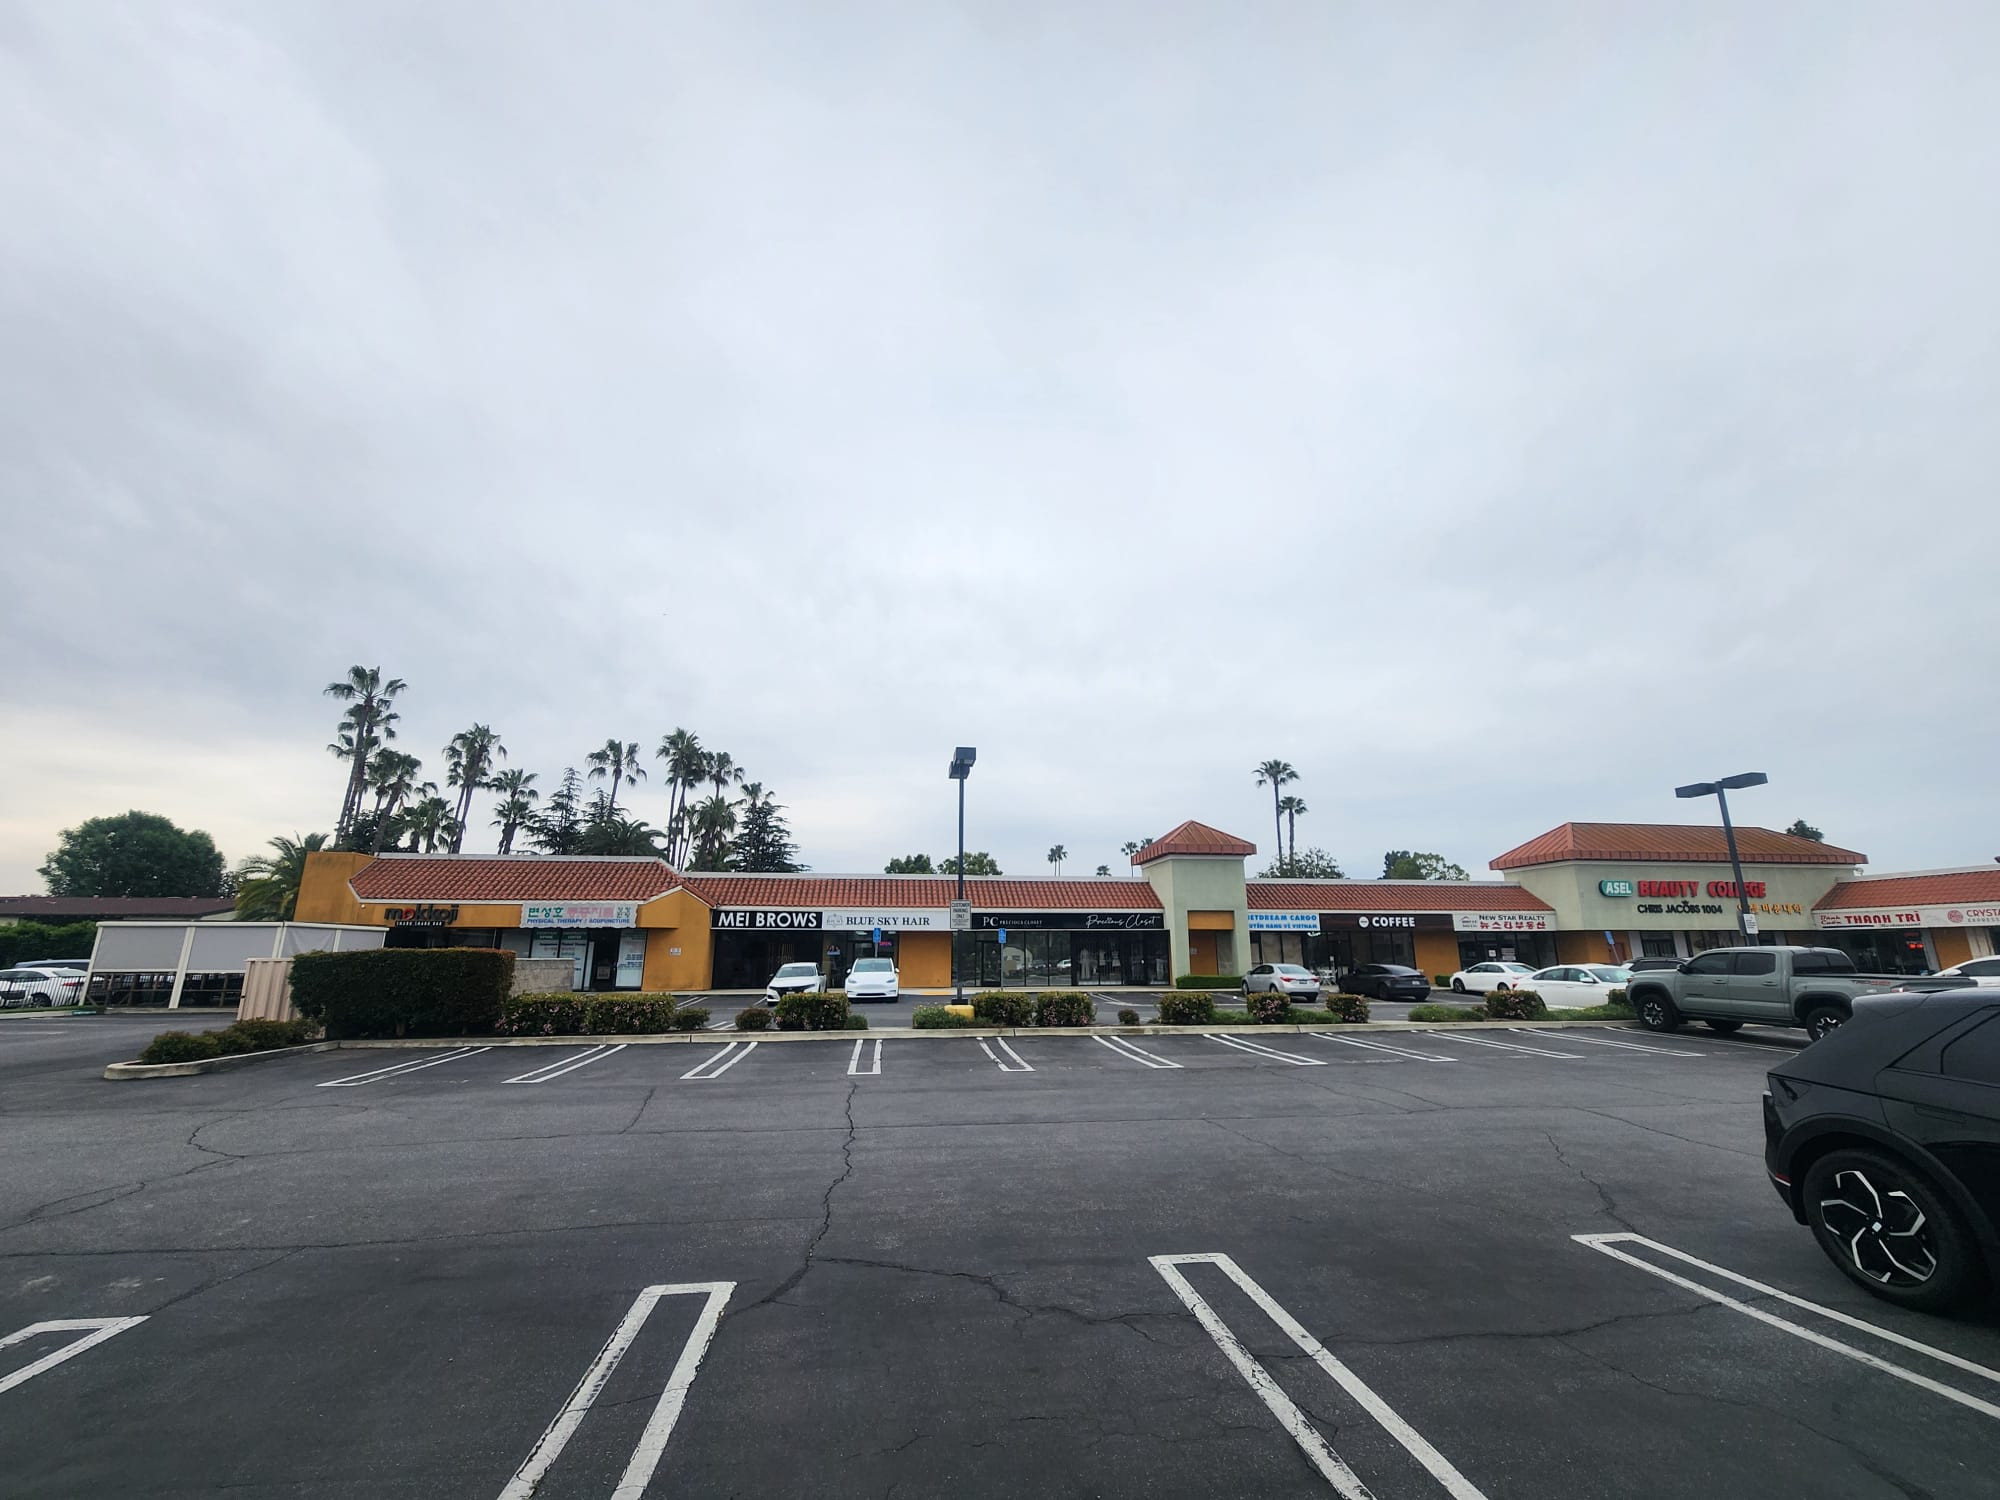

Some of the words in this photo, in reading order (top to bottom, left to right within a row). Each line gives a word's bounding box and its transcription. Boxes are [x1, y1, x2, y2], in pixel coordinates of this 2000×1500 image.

[1605, 882, 1632, 894] ASEL
[1637, 880, 1700, 898] BEAUTY
[384, 904, 460, 925] mokkoji
[1637, 904, 1664, 914] CHRIS
[1664, 903, 1701, 914] JACOBS
[1701, 904, 1723, 914] 1004
[718, 912, 750, 927] MEI
[755, 912, 817, 928] BROWS
[846, 917, 875, 926] BLUE
[877, 917, 900, 926] SKY
[902, 917, 931, 926] HAIR
[983, 917, 999, 927] PC
[1086, 914, 1125, 929] Precious
[1125, 914, 1160, 929] Closet
[1372, 916, 1416, 928] COFFEE
[1844, 915, 1891, 924] THANH
